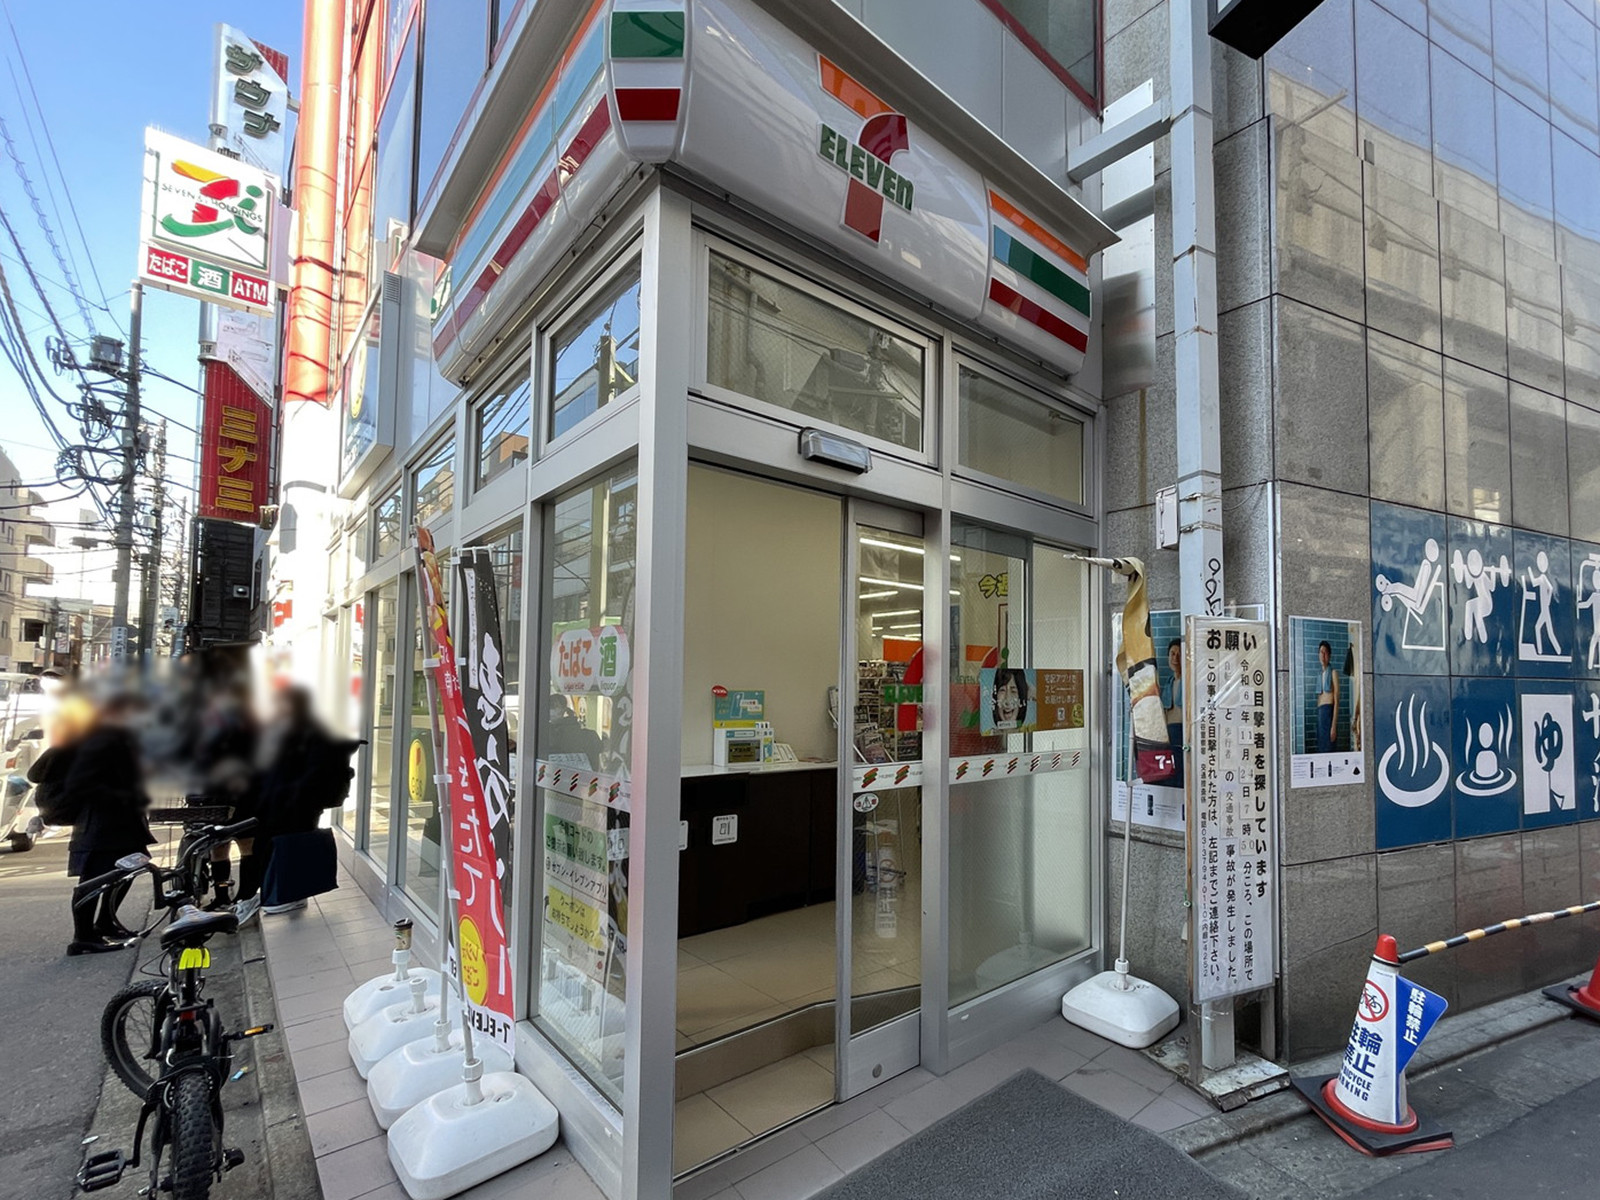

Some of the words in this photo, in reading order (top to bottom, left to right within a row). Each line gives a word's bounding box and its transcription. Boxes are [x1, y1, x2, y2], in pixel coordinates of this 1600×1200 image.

[225, 43, 280, 139] サウナ
[149, 252, 187, 283] たばこ
[197, 266, 223, 291] 酒
[232, 274, 268, 303] ATM
[558, 637, 593, 678] たばこ
[599, 635, 618, 677] 酒
[1206, 628, 1258, 651] お願い
